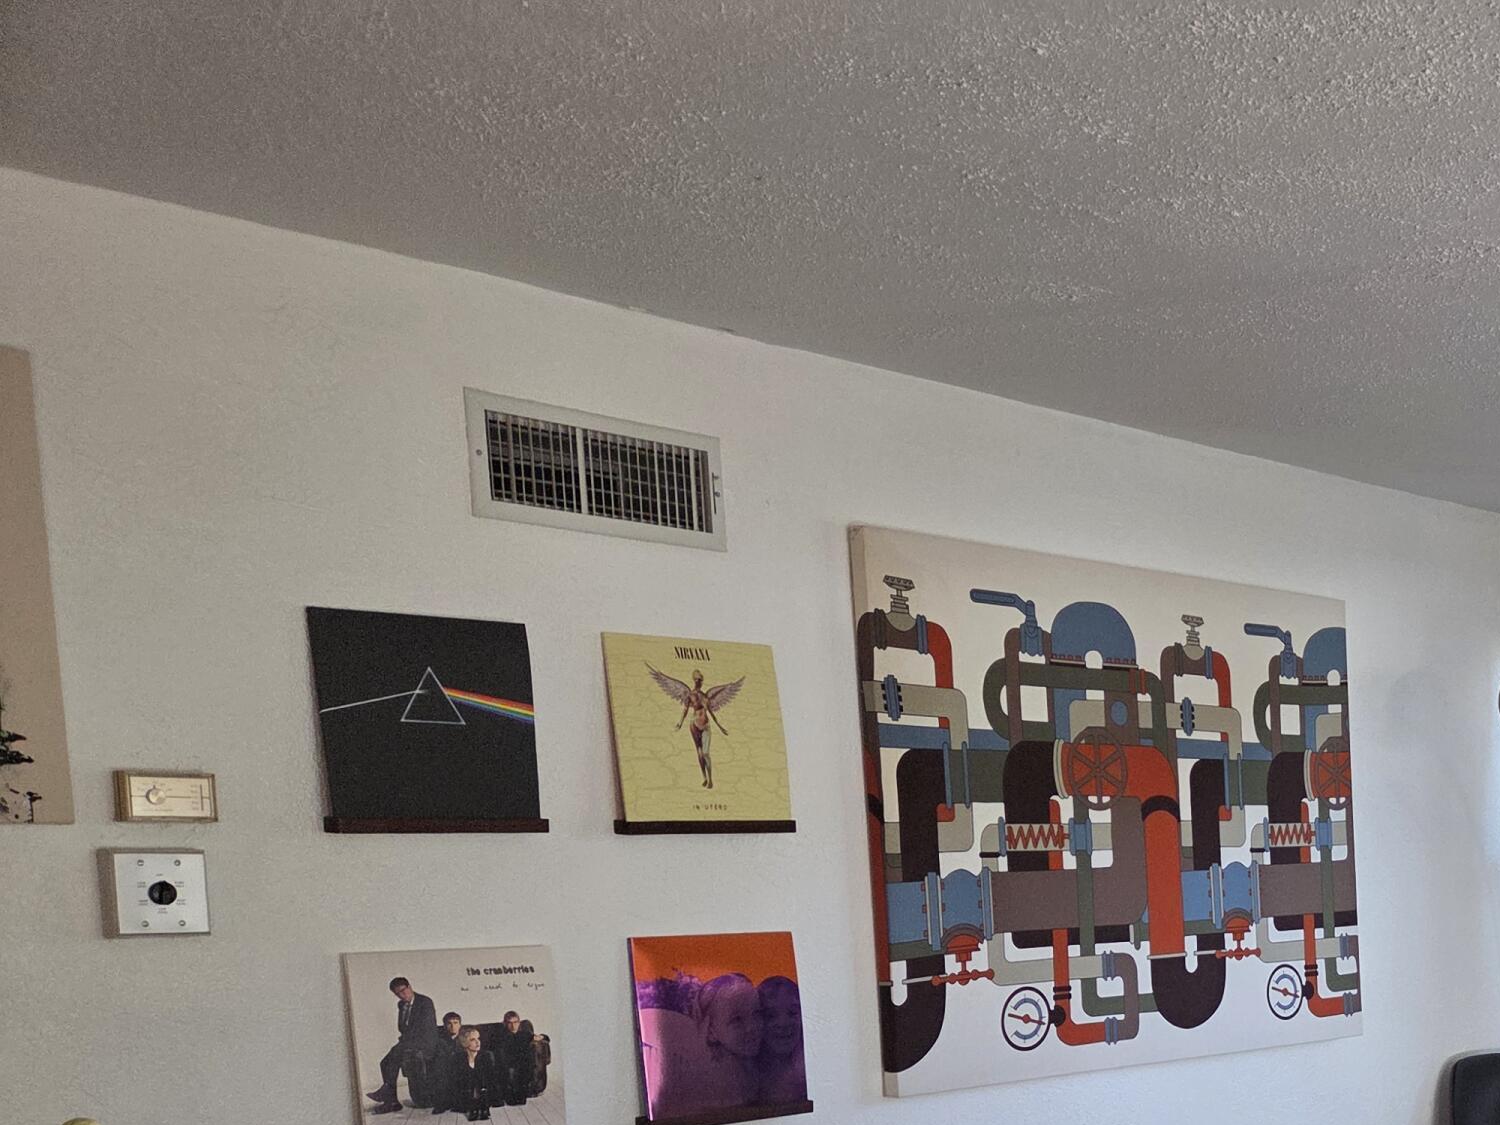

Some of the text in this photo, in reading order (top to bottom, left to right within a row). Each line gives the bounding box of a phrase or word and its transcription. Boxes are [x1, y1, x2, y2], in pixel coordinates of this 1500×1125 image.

[673, 645, 711, 661] NIRVANA
[466, 965, 535, 976] the cranberries
